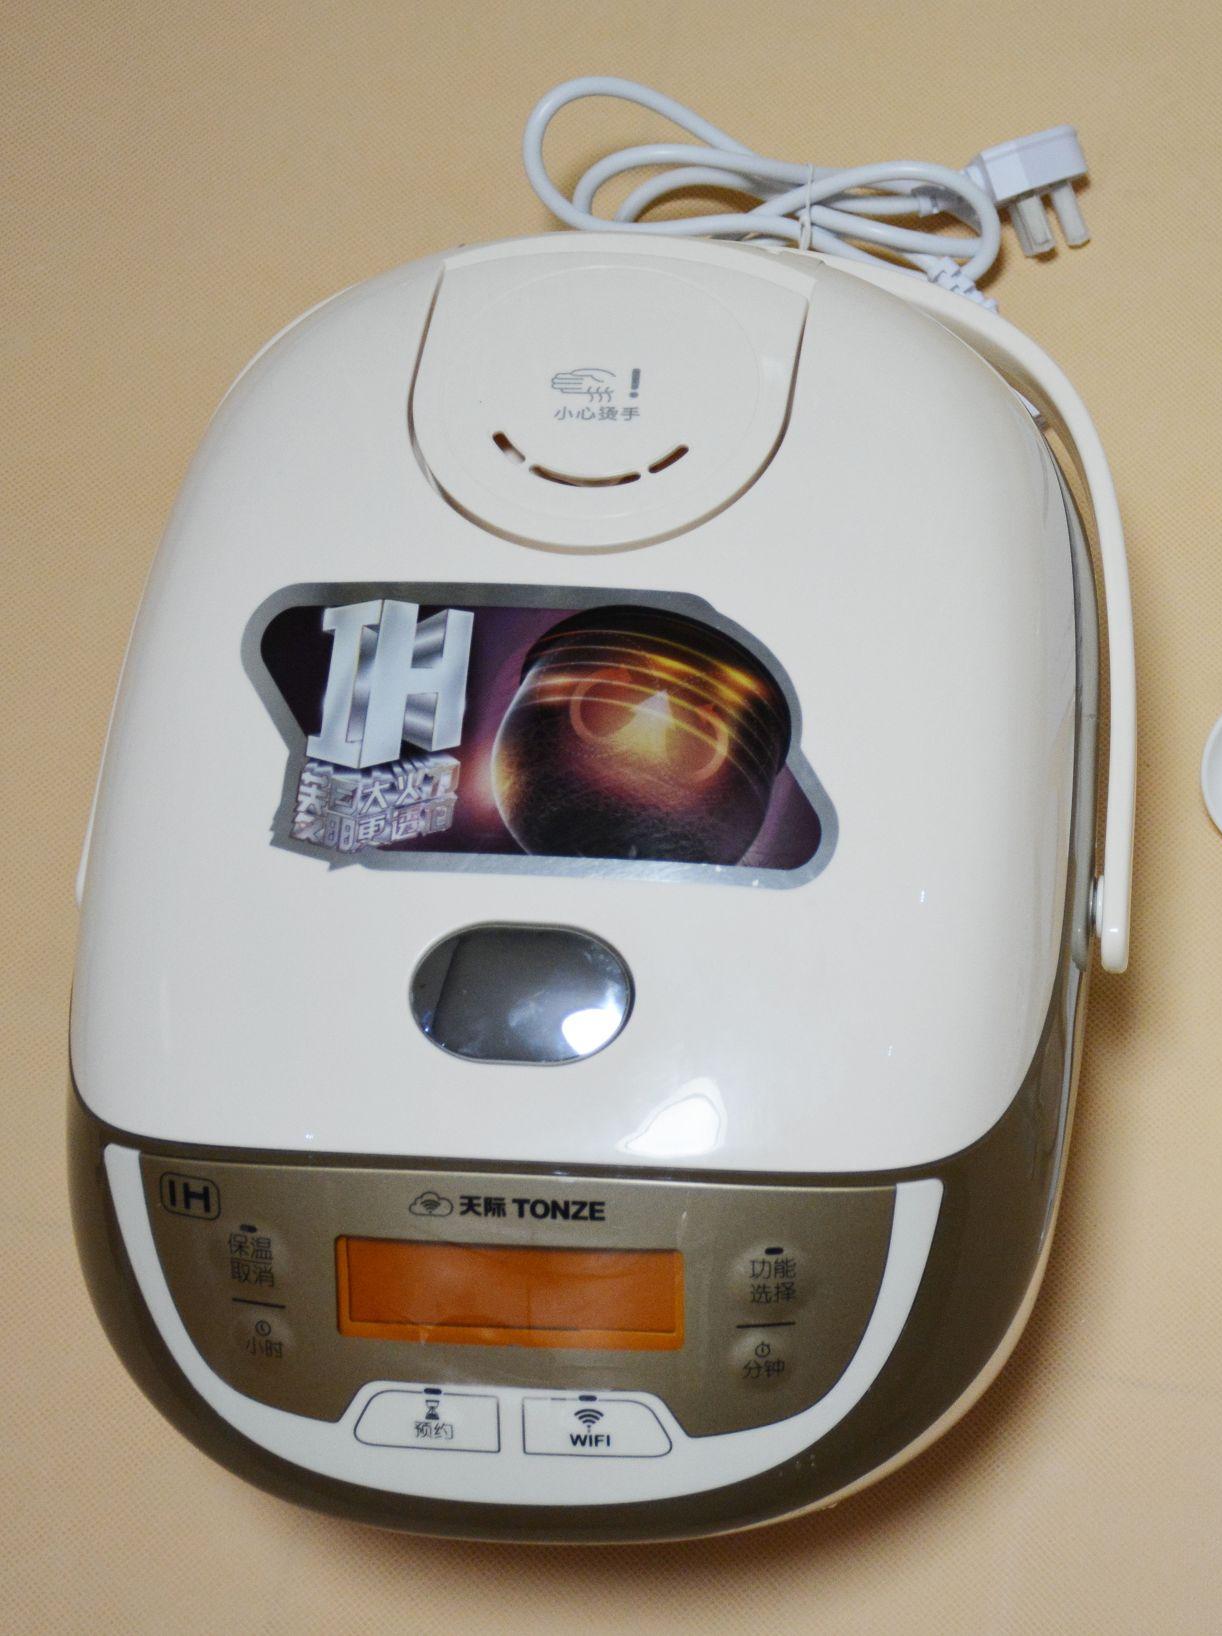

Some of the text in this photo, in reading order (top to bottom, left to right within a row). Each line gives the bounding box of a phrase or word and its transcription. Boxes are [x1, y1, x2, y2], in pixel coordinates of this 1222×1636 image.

[554, 405, 641, 422] 小心烫手
[307, 599, 474, 768] IH
[167, 1179, 212, 1213] IH
[460, 1195, 606, 1222] 天际 TONZE
[228, 1231, 274, 1259] 保温
[231, 1259, 276, 1288] 取消
[749, 1258, 796, 1280] 功能
[749, 1281, 796, 1304] 选择
[246, 1335, 283, 1359] 小时
[743, 1359, 785, 1380] 分钟
[415, 1420, 454, 1441] 预约
[570, 1433, 611, 1447] WIFI
